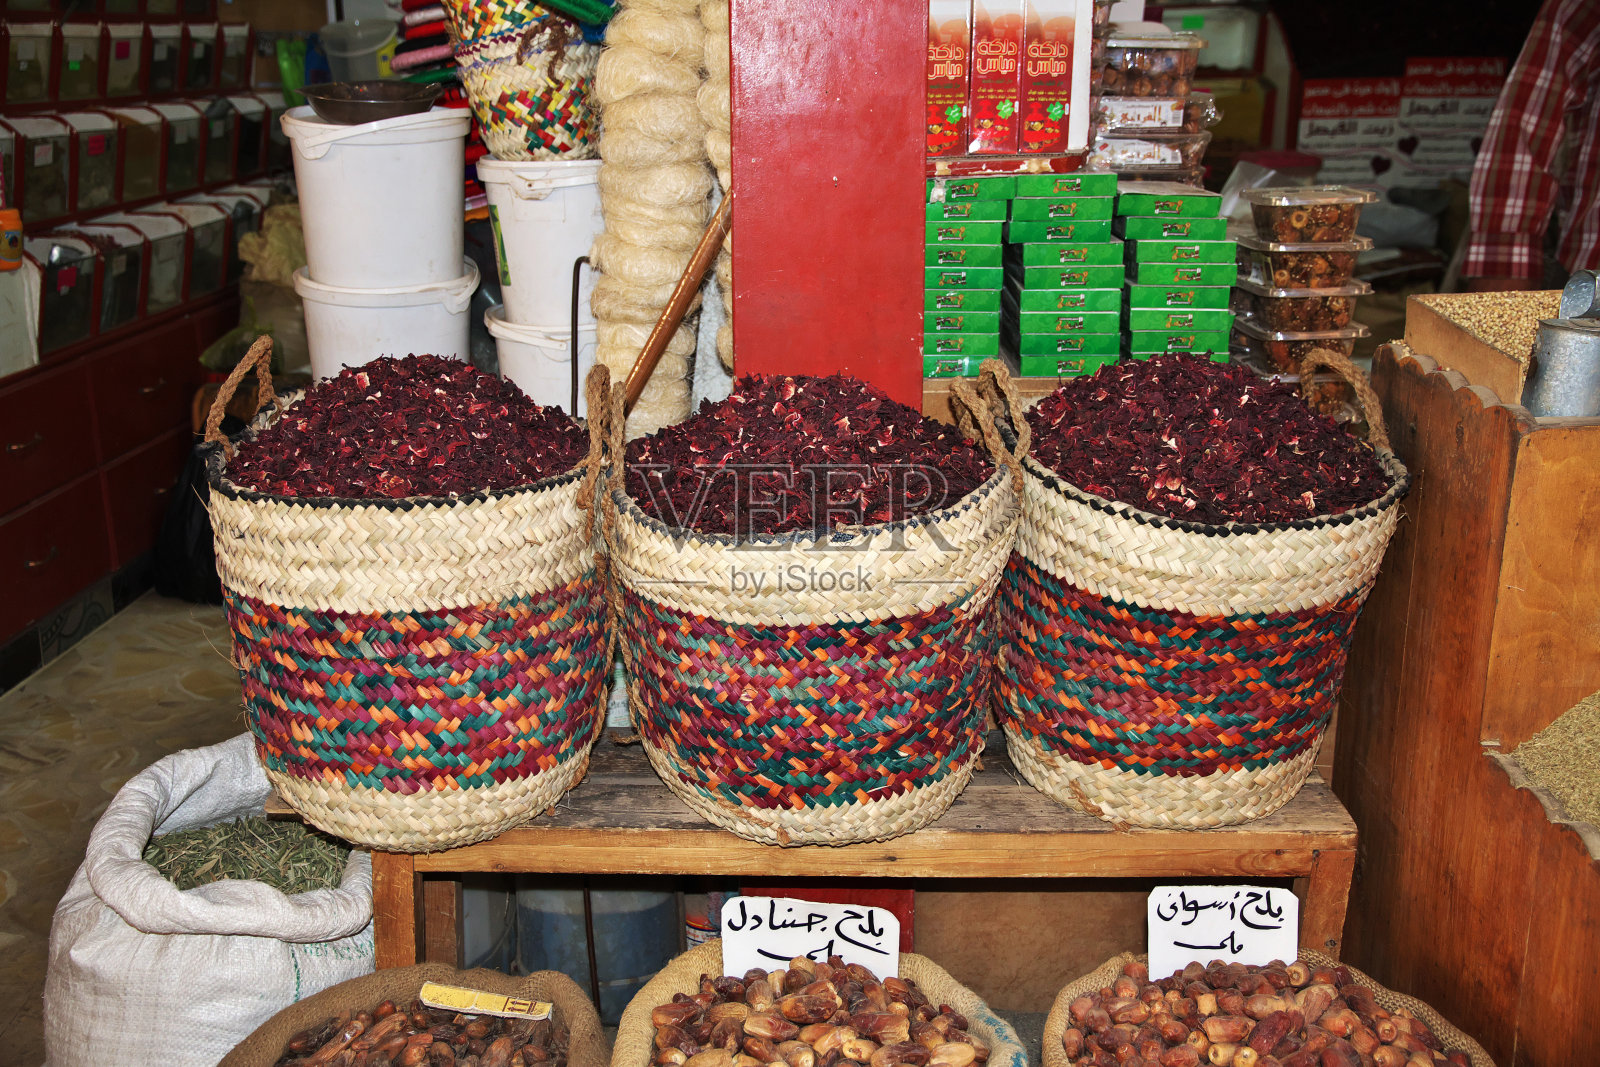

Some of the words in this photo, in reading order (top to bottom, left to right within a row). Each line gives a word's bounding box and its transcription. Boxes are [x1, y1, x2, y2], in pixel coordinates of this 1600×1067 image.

[977, 37, 1018, 55] دلكة
[1027, 39, 1069, 58] دلكة
[976, 55, 1016, 74] مياس
[1027, 58, 1067, 77] مياس
[1239, 889, 1284, 930] بلح
[835, 909, 890, 955] بلح
